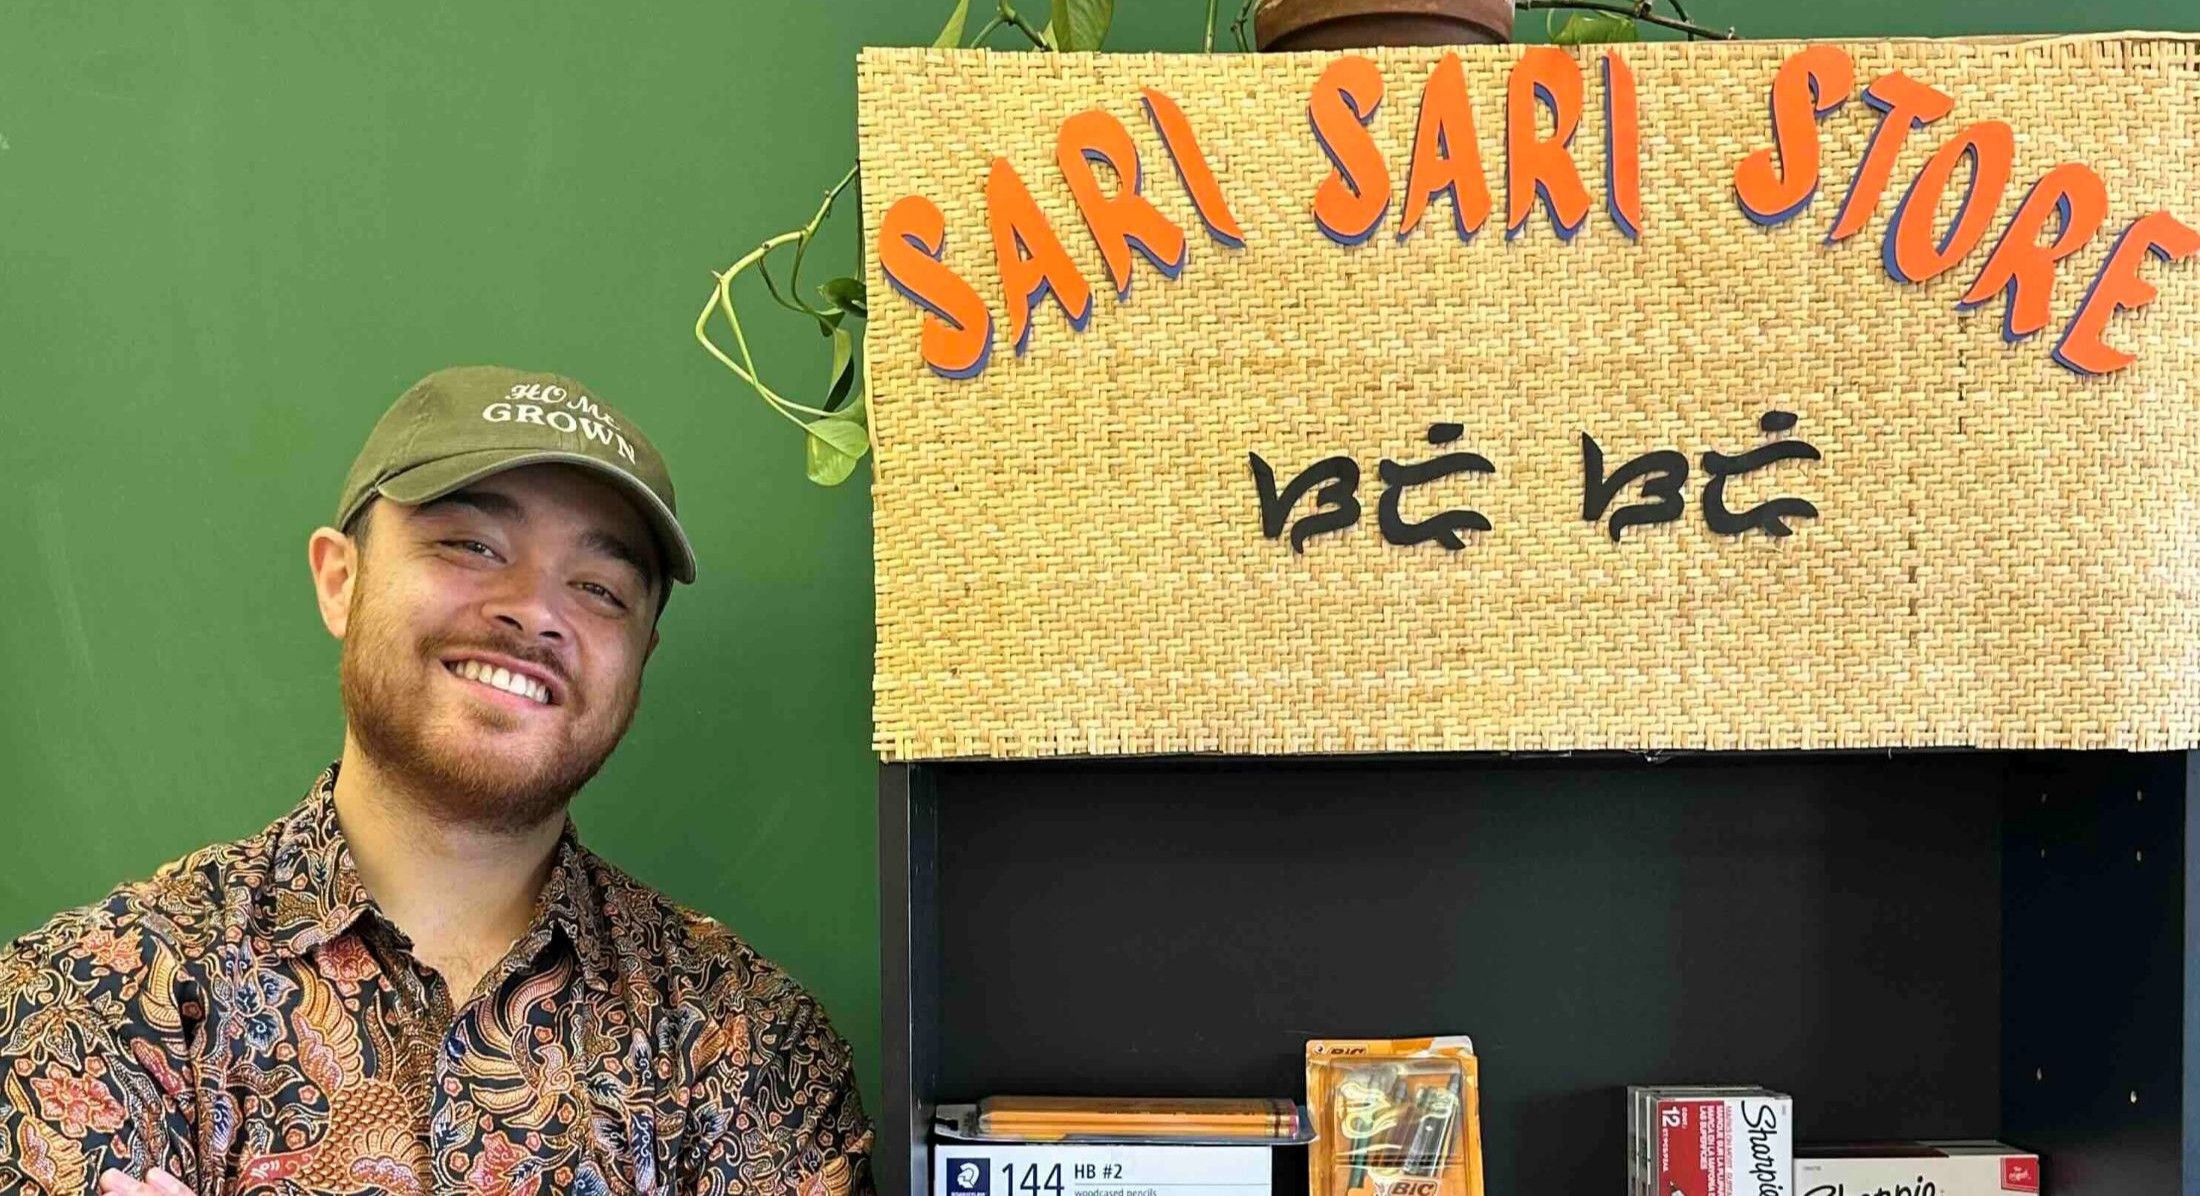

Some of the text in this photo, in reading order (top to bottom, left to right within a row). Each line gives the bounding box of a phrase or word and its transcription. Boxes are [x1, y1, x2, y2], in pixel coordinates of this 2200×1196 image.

[878, 44, 2200, 379] SARI SARI STORE
[482, 403, 636, 465] GROWN
[1662, 1106, 1681, 1127] 12
[1001, 1163, 1065, 1196] 144
[1074, 1164, 1123, 1179] HB #2
